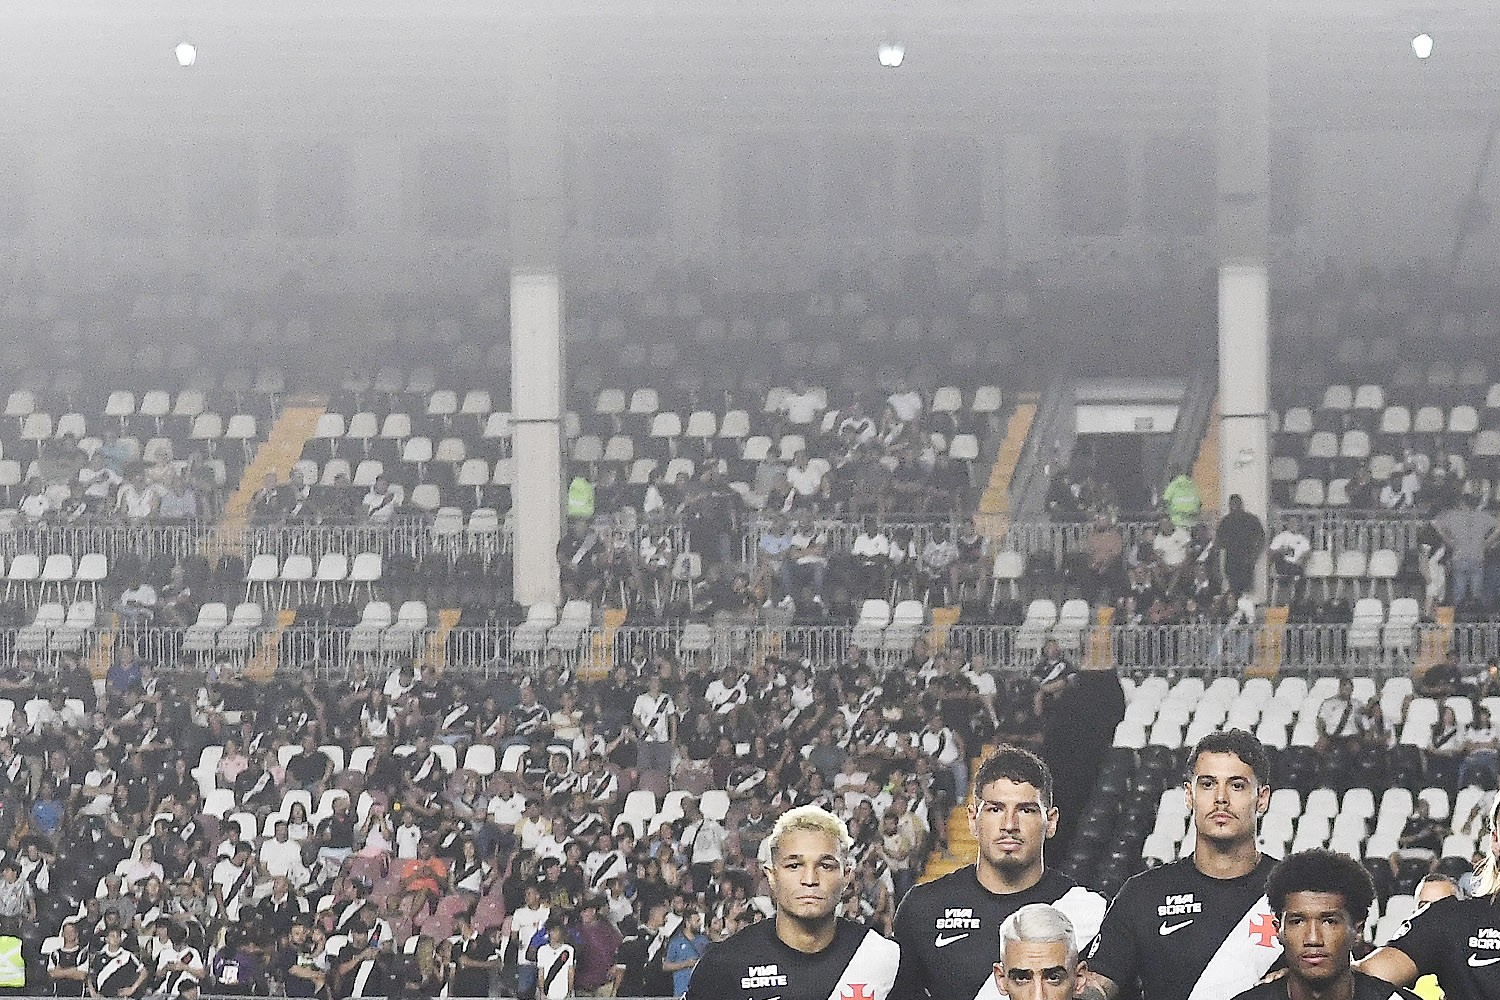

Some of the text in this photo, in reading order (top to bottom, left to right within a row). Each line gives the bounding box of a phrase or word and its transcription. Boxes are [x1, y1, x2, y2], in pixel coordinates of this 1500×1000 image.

[1165, 893, 1194, 905] VIVA
[945, 908, 973, 919] VIVA
[1157, 902, 1201, 916] SORTE
[936, 918, 980, 929] SORTE
[748, 965, 777, 977] VIVA
[741, 974, 787, 989] SORTE
